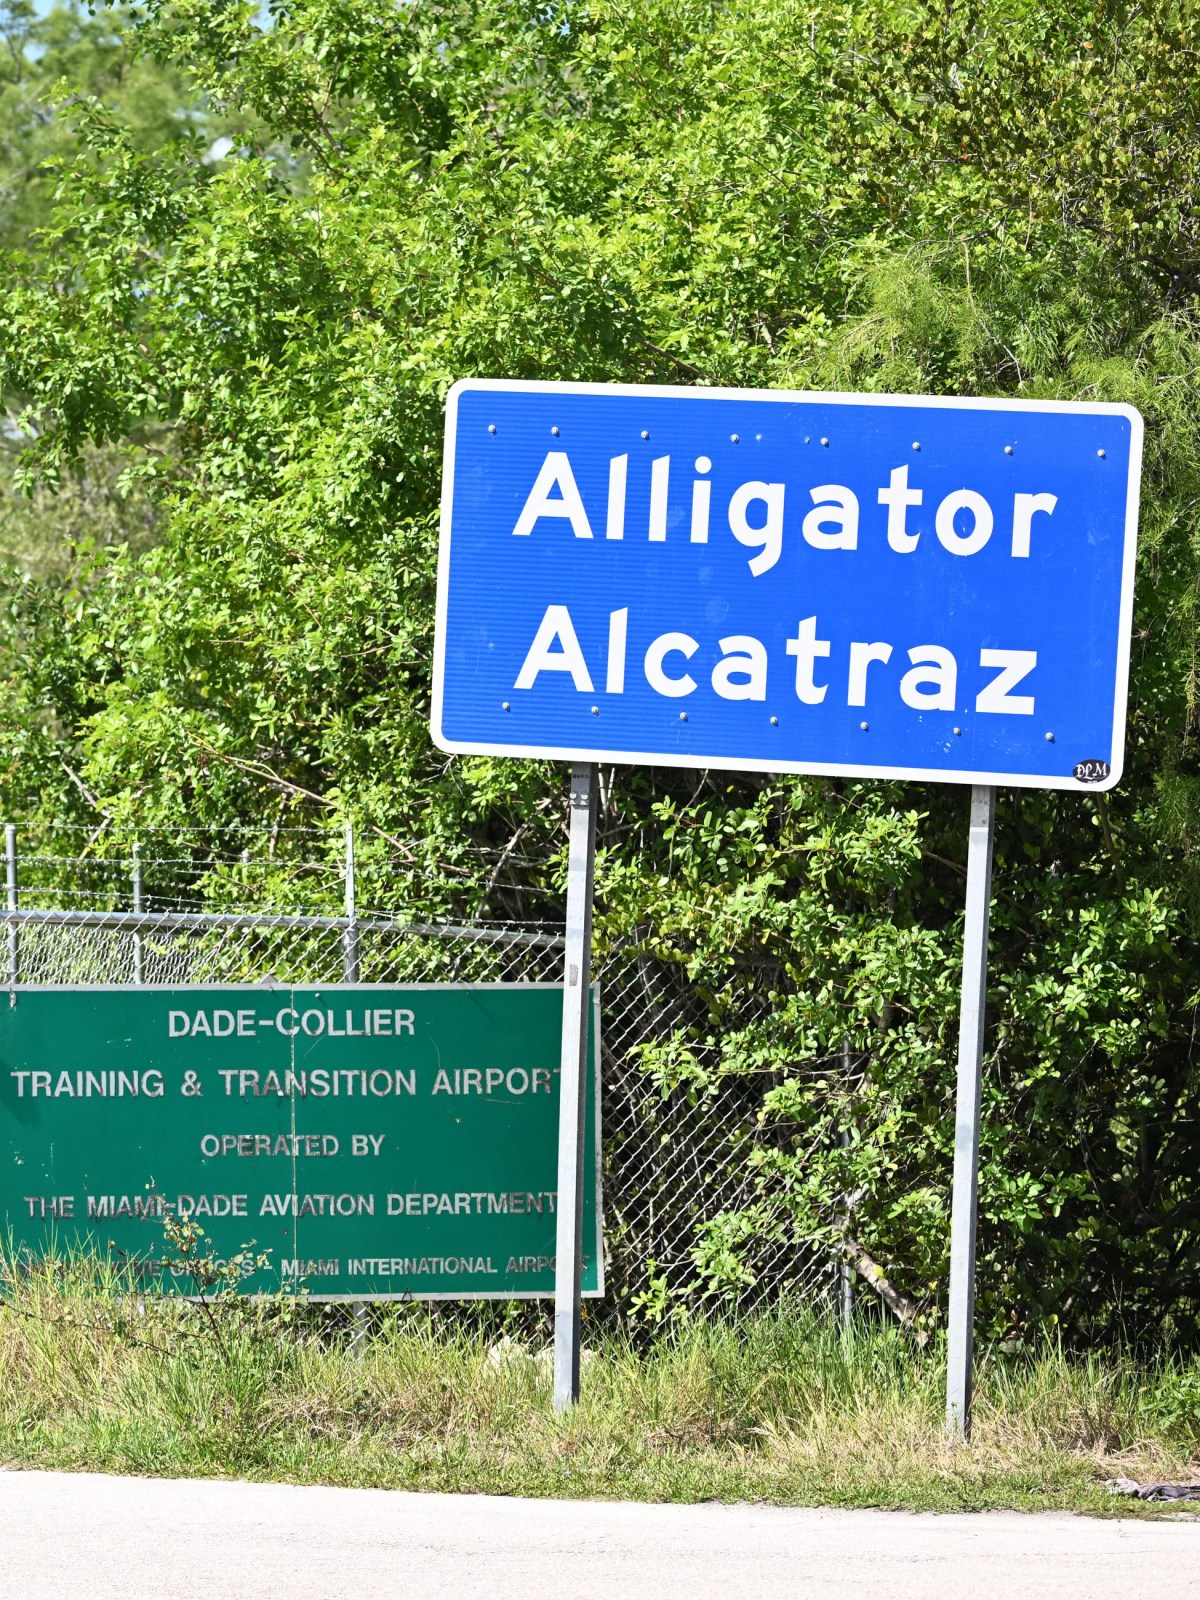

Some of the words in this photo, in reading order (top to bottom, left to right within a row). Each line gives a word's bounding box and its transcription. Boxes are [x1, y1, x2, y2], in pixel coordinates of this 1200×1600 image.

[512, 451, 1058, 578] Alligator
[513, 604, 1038, 716] Alcatraz
[168, 1008, 416, 1037] DADE-COLLIER
[11, 1070, 165, 1098] TRAINING
[180, 1069, 203, 1098] &
[218, 1068, 417, 1098] TRANSITION
[431, 1067, 561, 1096] AIRPOR
[200, 1134, 340, 1158] OPERATED
[351, 1134, 385, 1157] BY
[24, 1196, 75, 1219] THE
[87, 1194, 249, 1218] MIAMI-DADE
[259, 1194, 375, 1217] AVIATION
[387, 1192, 558, 1216] DEPARTMENT
[281, 1258, 339, 1277] MIAMI
[348, 1256, 498, 1276] INTERNATIONAL
